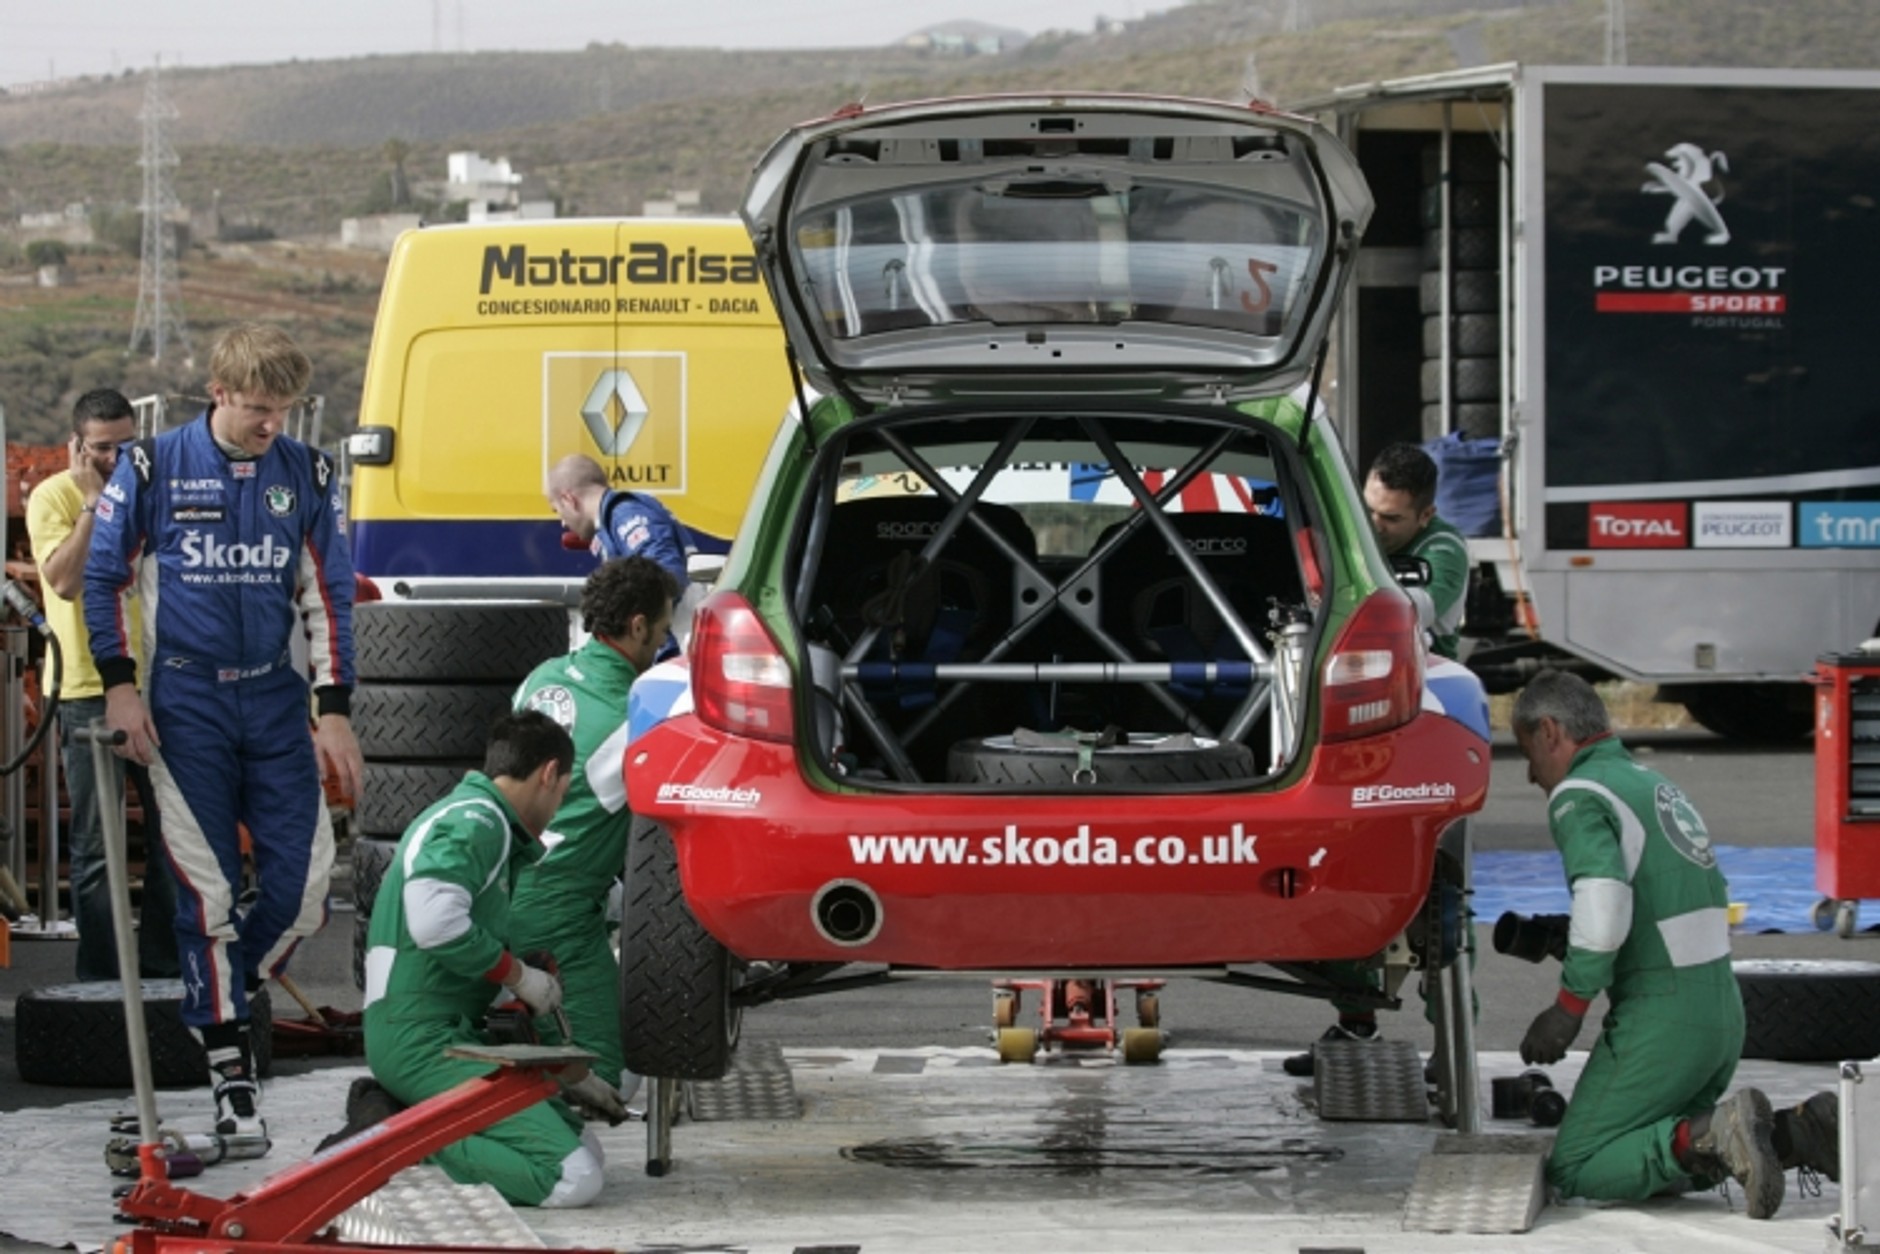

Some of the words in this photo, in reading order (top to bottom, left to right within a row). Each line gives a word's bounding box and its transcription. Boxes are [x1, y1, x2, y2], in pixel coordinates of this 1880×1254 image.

[1594, 266, 1786, 288] PEUGEOT
[478, 299, 611, 315] CONCESIONARIO
[617, 298, 690, 313] RENAULT
[709, 298, 760, 313] DACIA
[1690, 296, 1781, 313] SPORT
[1692, 316, 1784, 328] PORTUGAL
[180, 479, 224, 490] VARTA
[1702, 522, 1782, 536] PEUGEOT
[181, 529, 290, 568] Škoda
[657, 783, 761, 802] BFGoodrich
[1351, 783, 1456, 802] BFGoodrich
[848, 823, 1259, 865] www.skoda.co.uk
